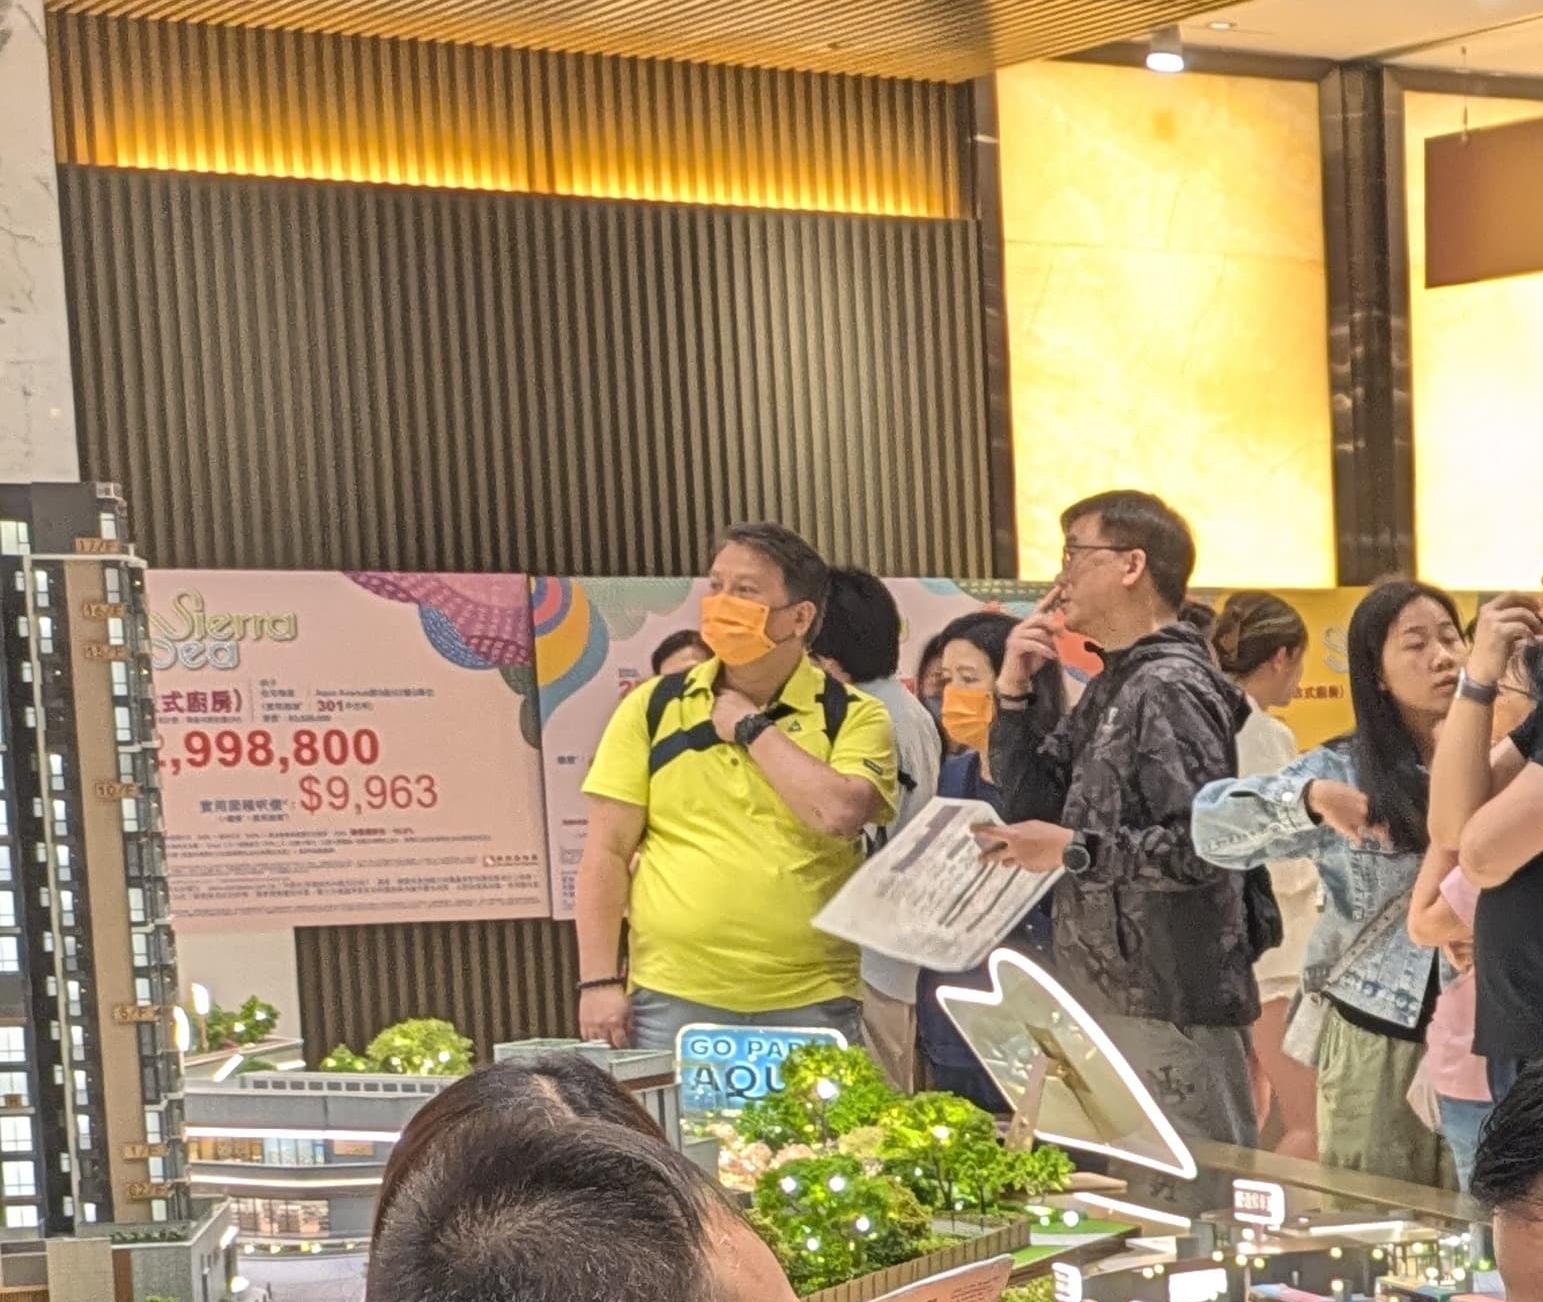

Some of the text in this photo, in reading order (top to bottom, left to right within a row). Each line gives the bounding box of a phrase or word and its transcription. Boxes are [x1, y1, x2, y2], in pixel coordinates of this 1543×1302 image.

[151, 587, 299, 641] Sierra
[318, 700, 343, 712] 301
[300, 774, 438, 815] $9,963
[691, 1039, 732, 1056] GO
